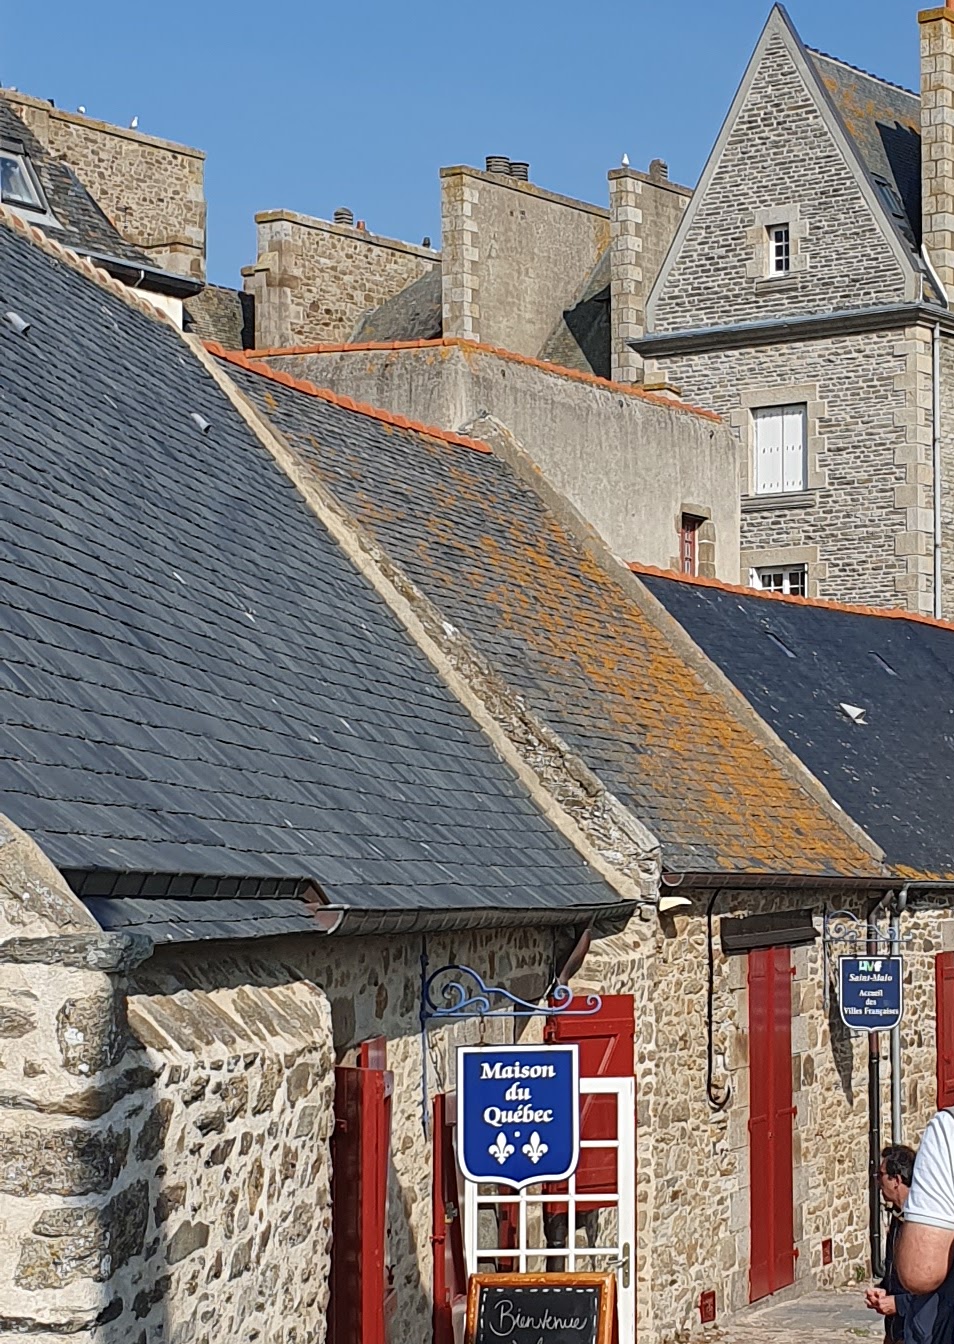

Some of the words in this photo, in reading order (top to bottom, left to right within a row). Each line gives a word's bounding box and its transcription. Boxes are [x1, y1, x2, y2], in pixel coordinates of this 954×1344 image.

[848, 973, 893, 981] Saint-Malo
[864, 1007, 899, 1016] Françaises
[480, 1061, 556, 1080] Maison
[505, 1081, 532, 1101] du
[483, 1103, 554, 1127] Québec
[489, 1299, 588, 1337] Bienvenue
